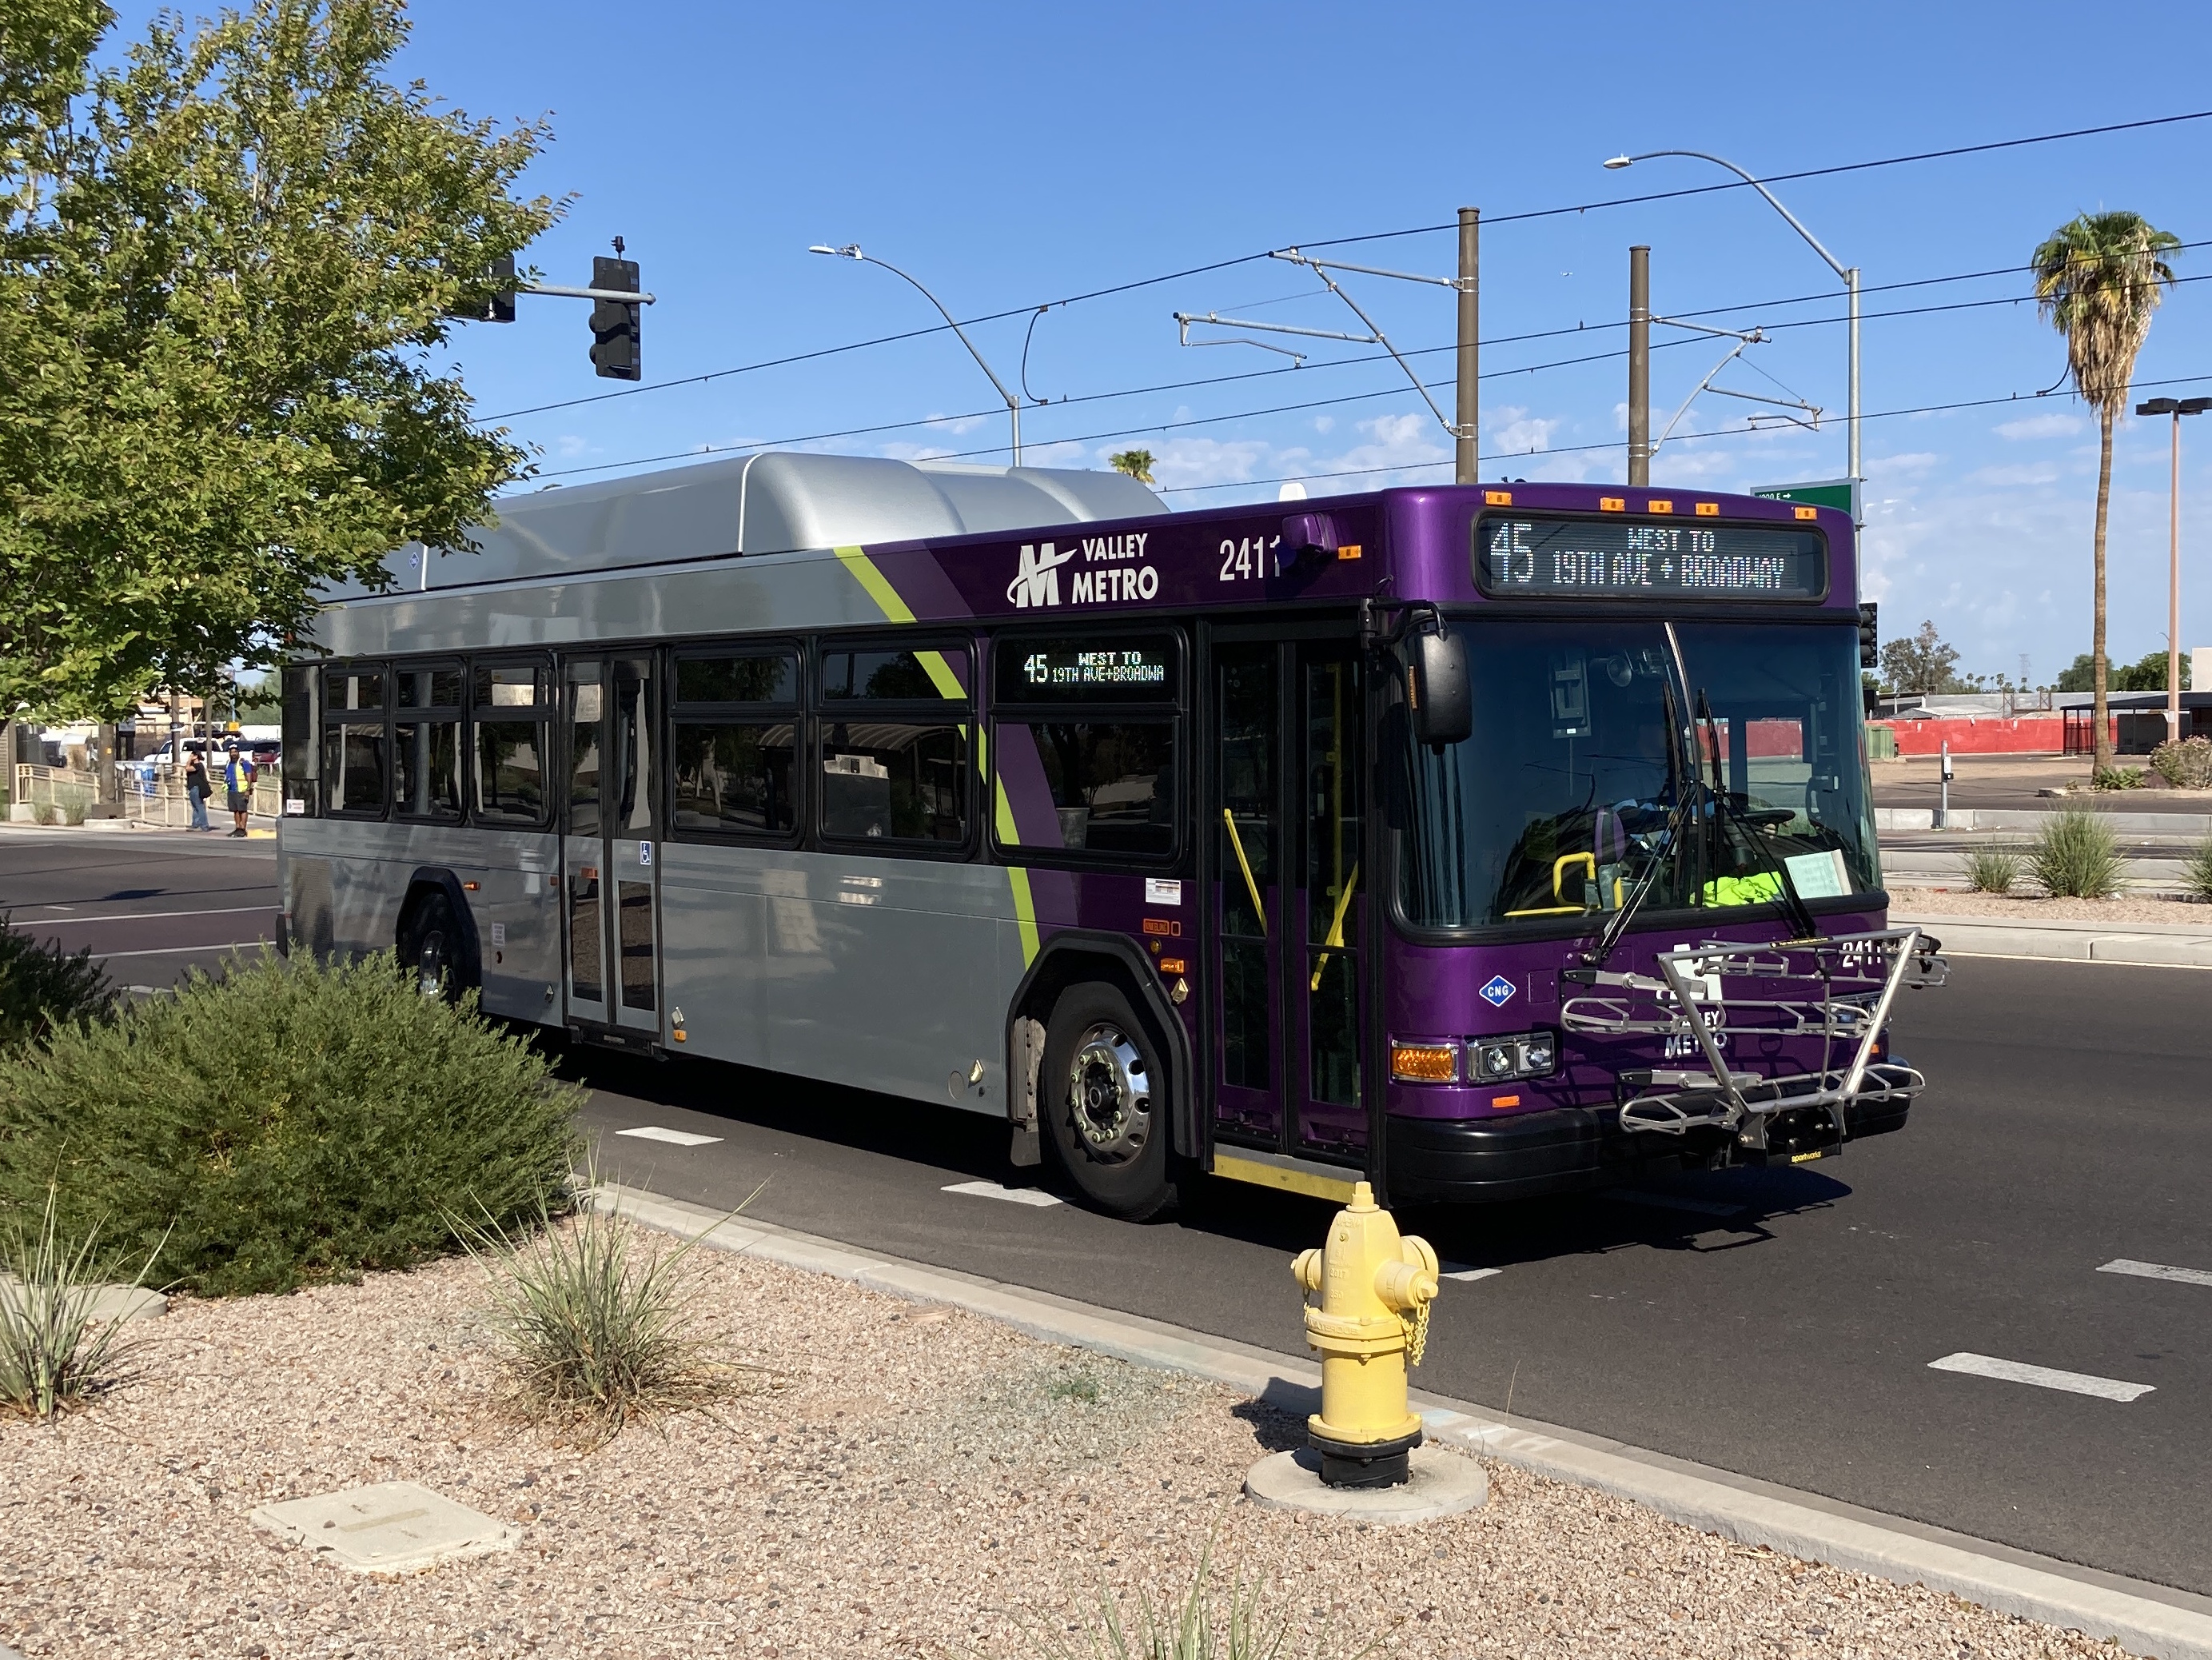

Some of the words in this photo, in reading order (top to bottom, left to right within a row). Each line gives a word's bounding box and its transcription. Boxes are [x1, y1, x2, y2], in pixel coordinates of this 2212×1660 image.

[1082, 533, 1149, 562] VALLEY
[1490, 522, 1534, 583] 45
[1628, 528, 1681, 551] WEST
[1688, 530, 1715, 552] TO
[1219, 534, 1281, 581] 2411
[1552, 550, 1604, 585] 19TH
[1612, 552, 1652, 585] AVE
[1680, 554, 1785, 589] BROADWAY
[1071, 565, 1159, 605] METRO
[1023, 654, 1049, 683] 45
[1078, 652, 1117, 666] WEST
[1121, 651, 1142, 665] TO
[1052, 667, 1079, 683] 19TH
[1487, 984, 1509, 997] CNG
[1664, 1032, 1728, 1058] METO
